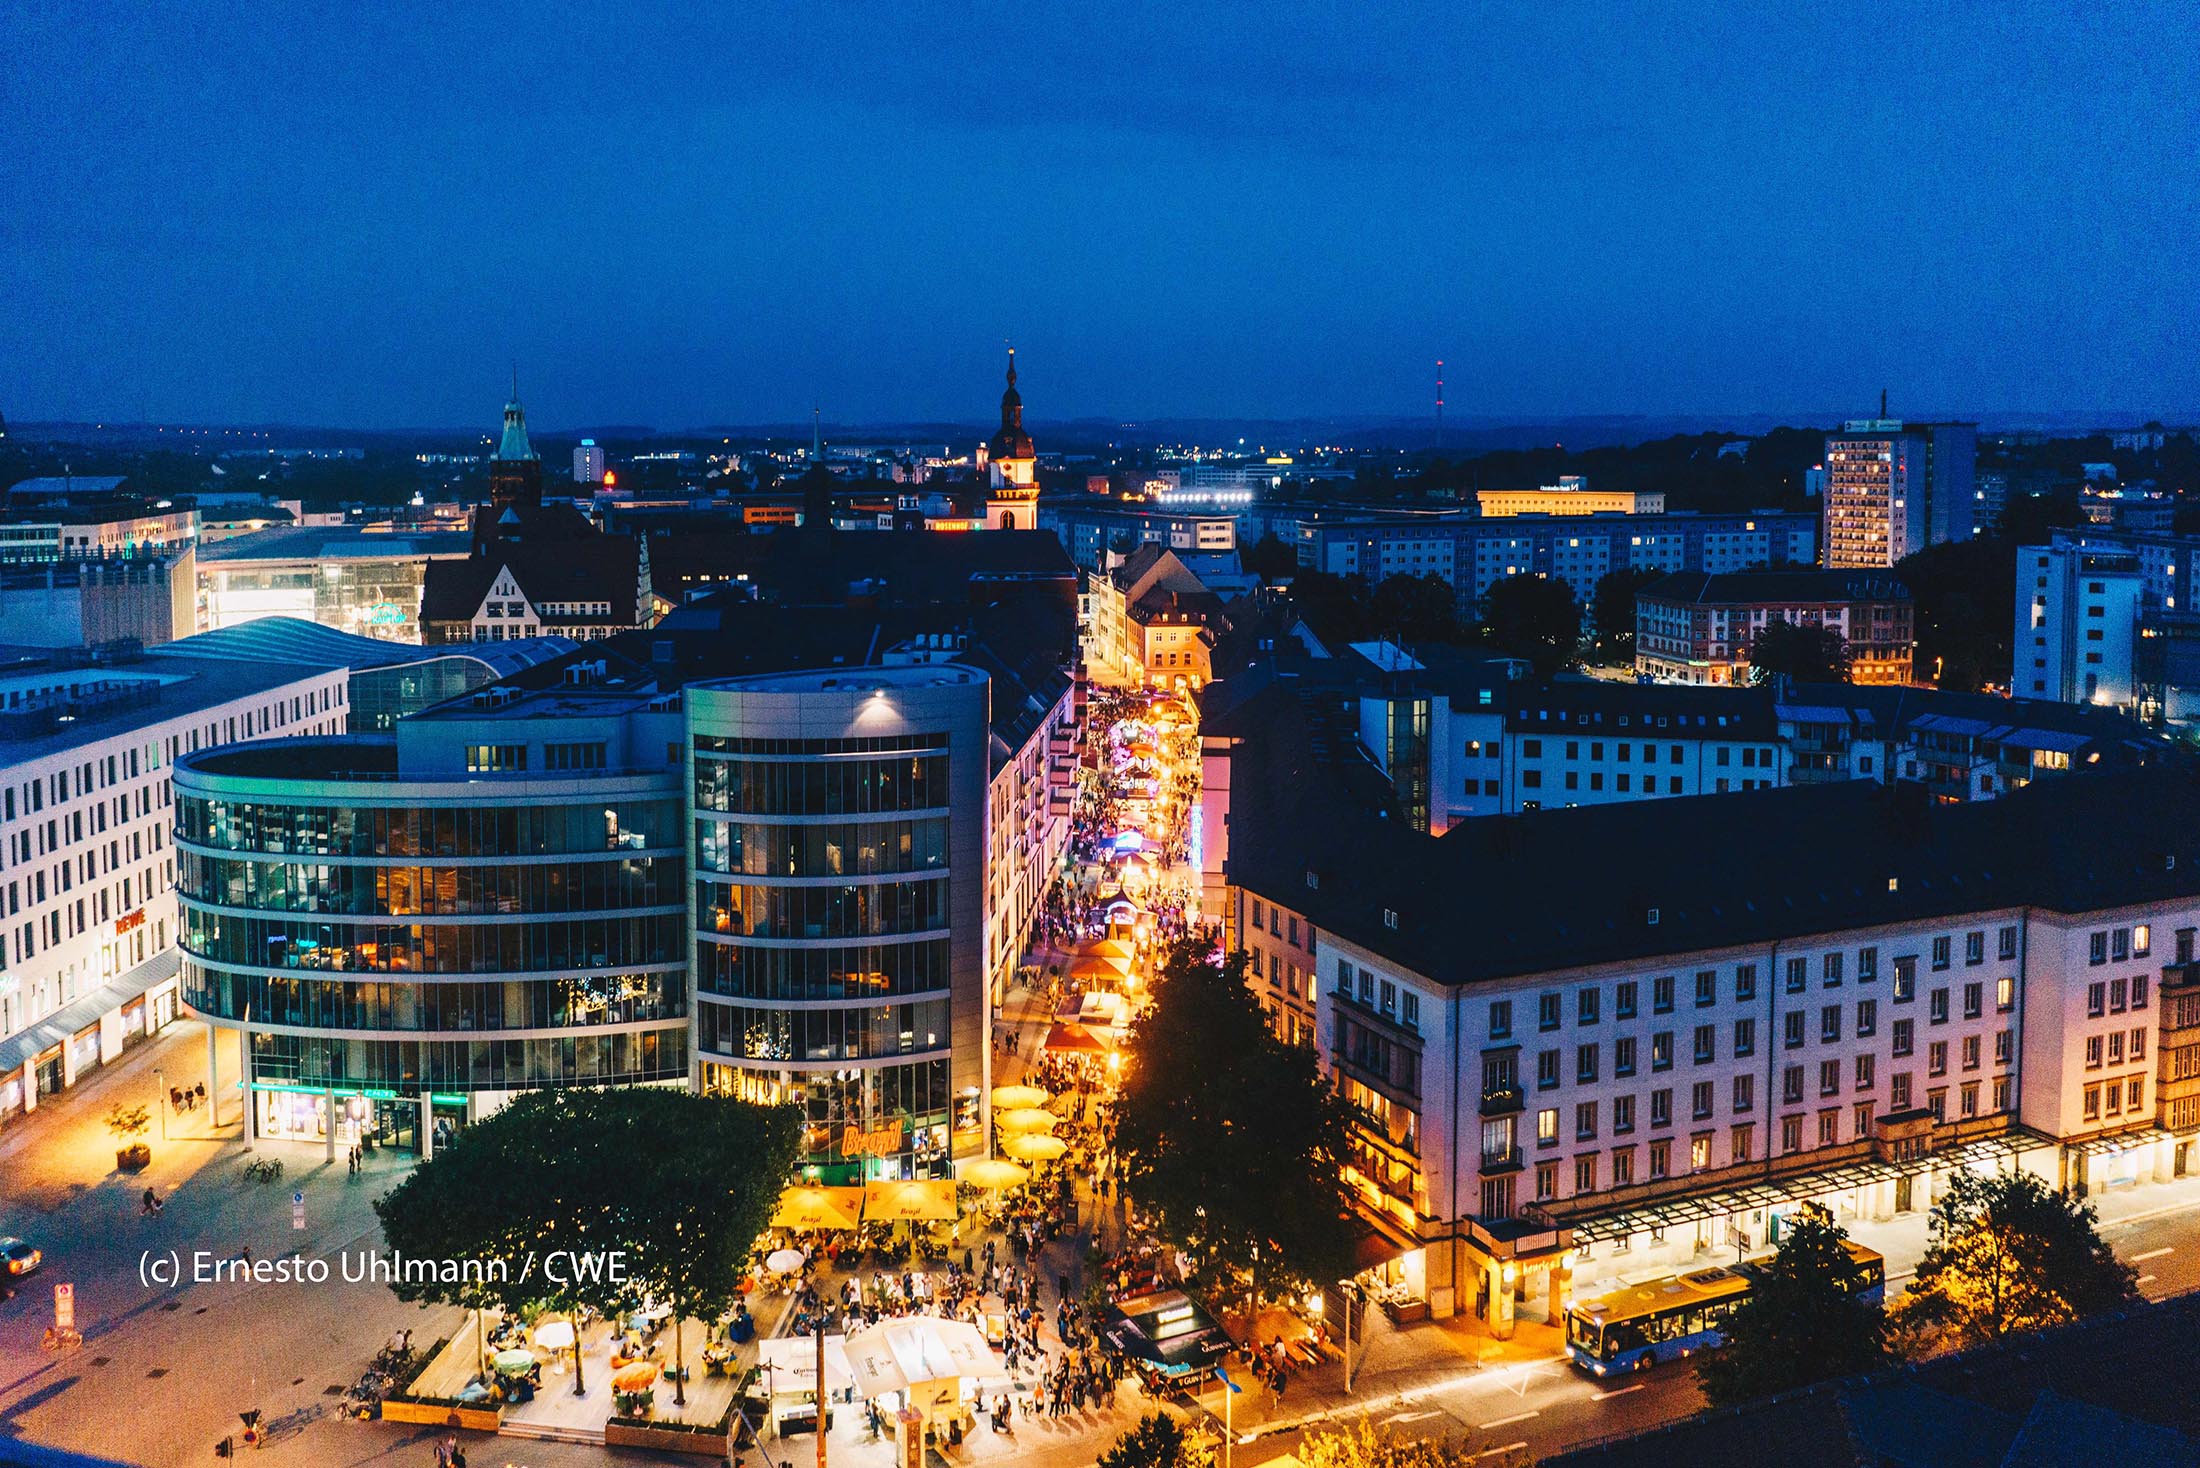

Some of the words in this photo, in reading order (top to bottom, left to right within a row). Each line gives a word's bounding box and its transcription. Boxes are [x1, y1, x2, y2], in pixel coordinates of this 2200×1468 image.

[115, 907, 145, 936] REWE
[841, 1120, 903, 1158] Brazil
[800, 1215, 822, 1224] Brazil
[900, 1207, 921, 1216] Brazil
